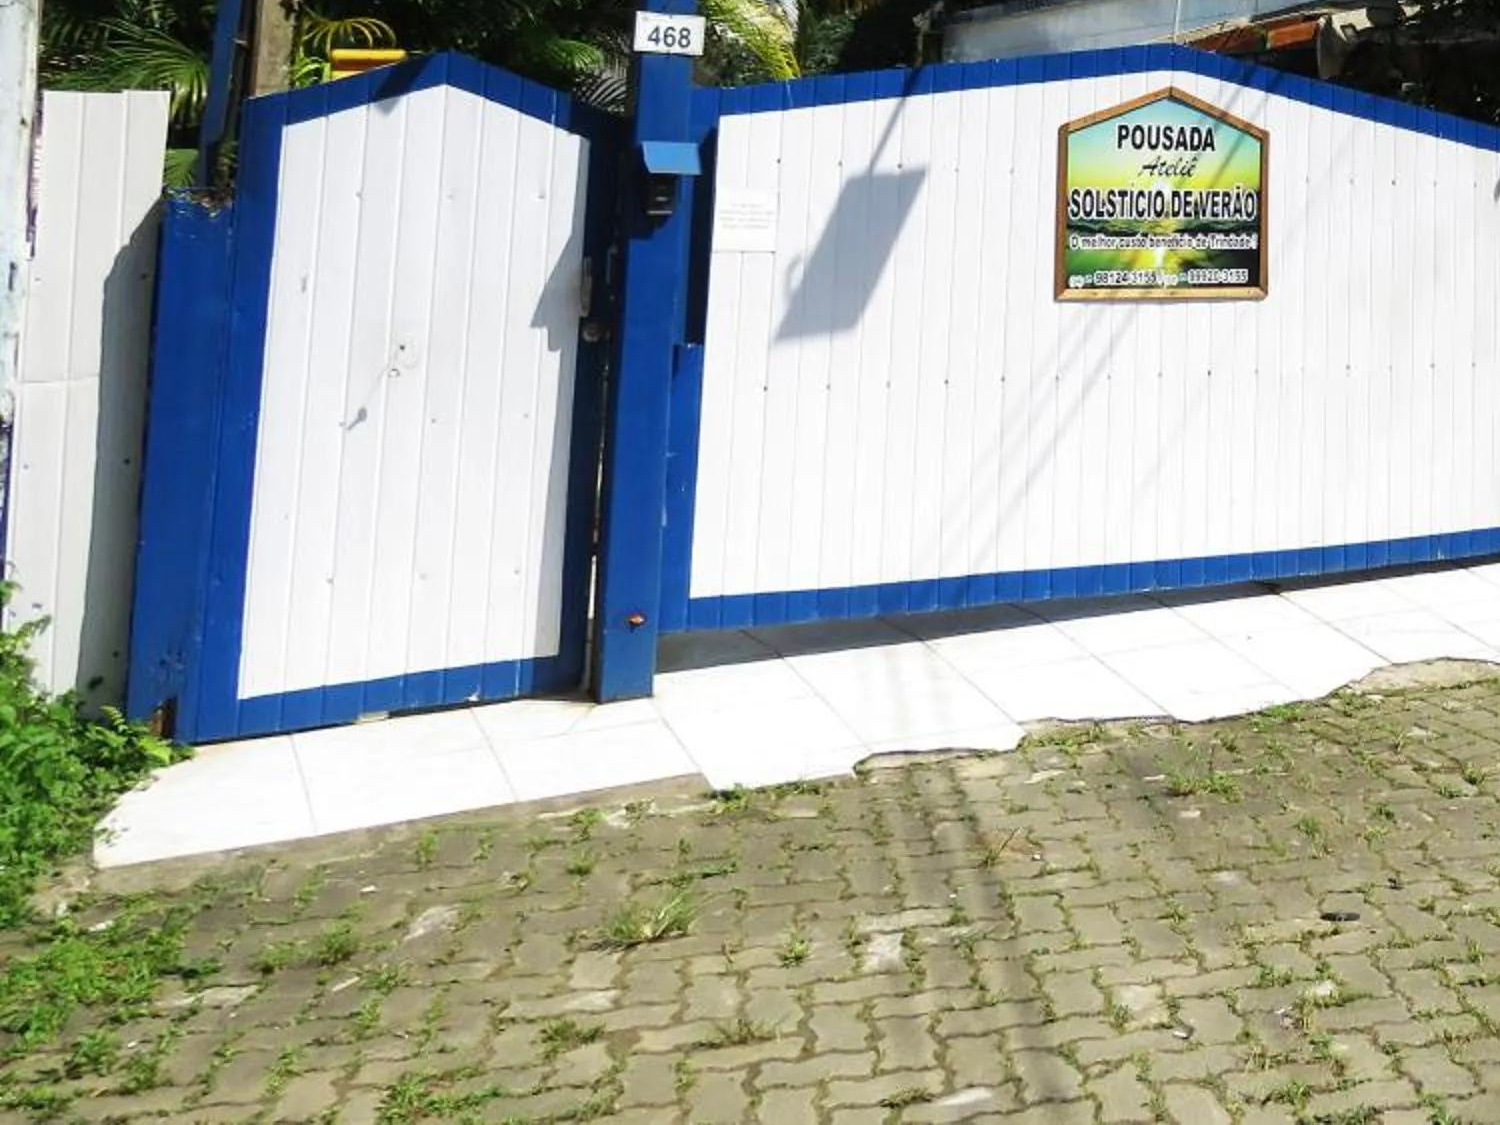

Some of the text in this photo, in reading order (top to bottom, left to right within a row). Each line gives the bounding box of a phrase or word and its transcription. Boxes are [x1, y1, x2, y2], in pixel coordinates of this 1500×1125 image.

[648, 25, 691, 49] 468
[1117, 124, 1215, 152] POUSADA
[1171, 191, 1192, 218] DE
[1199, 186, 1256, 219] VERÃO
